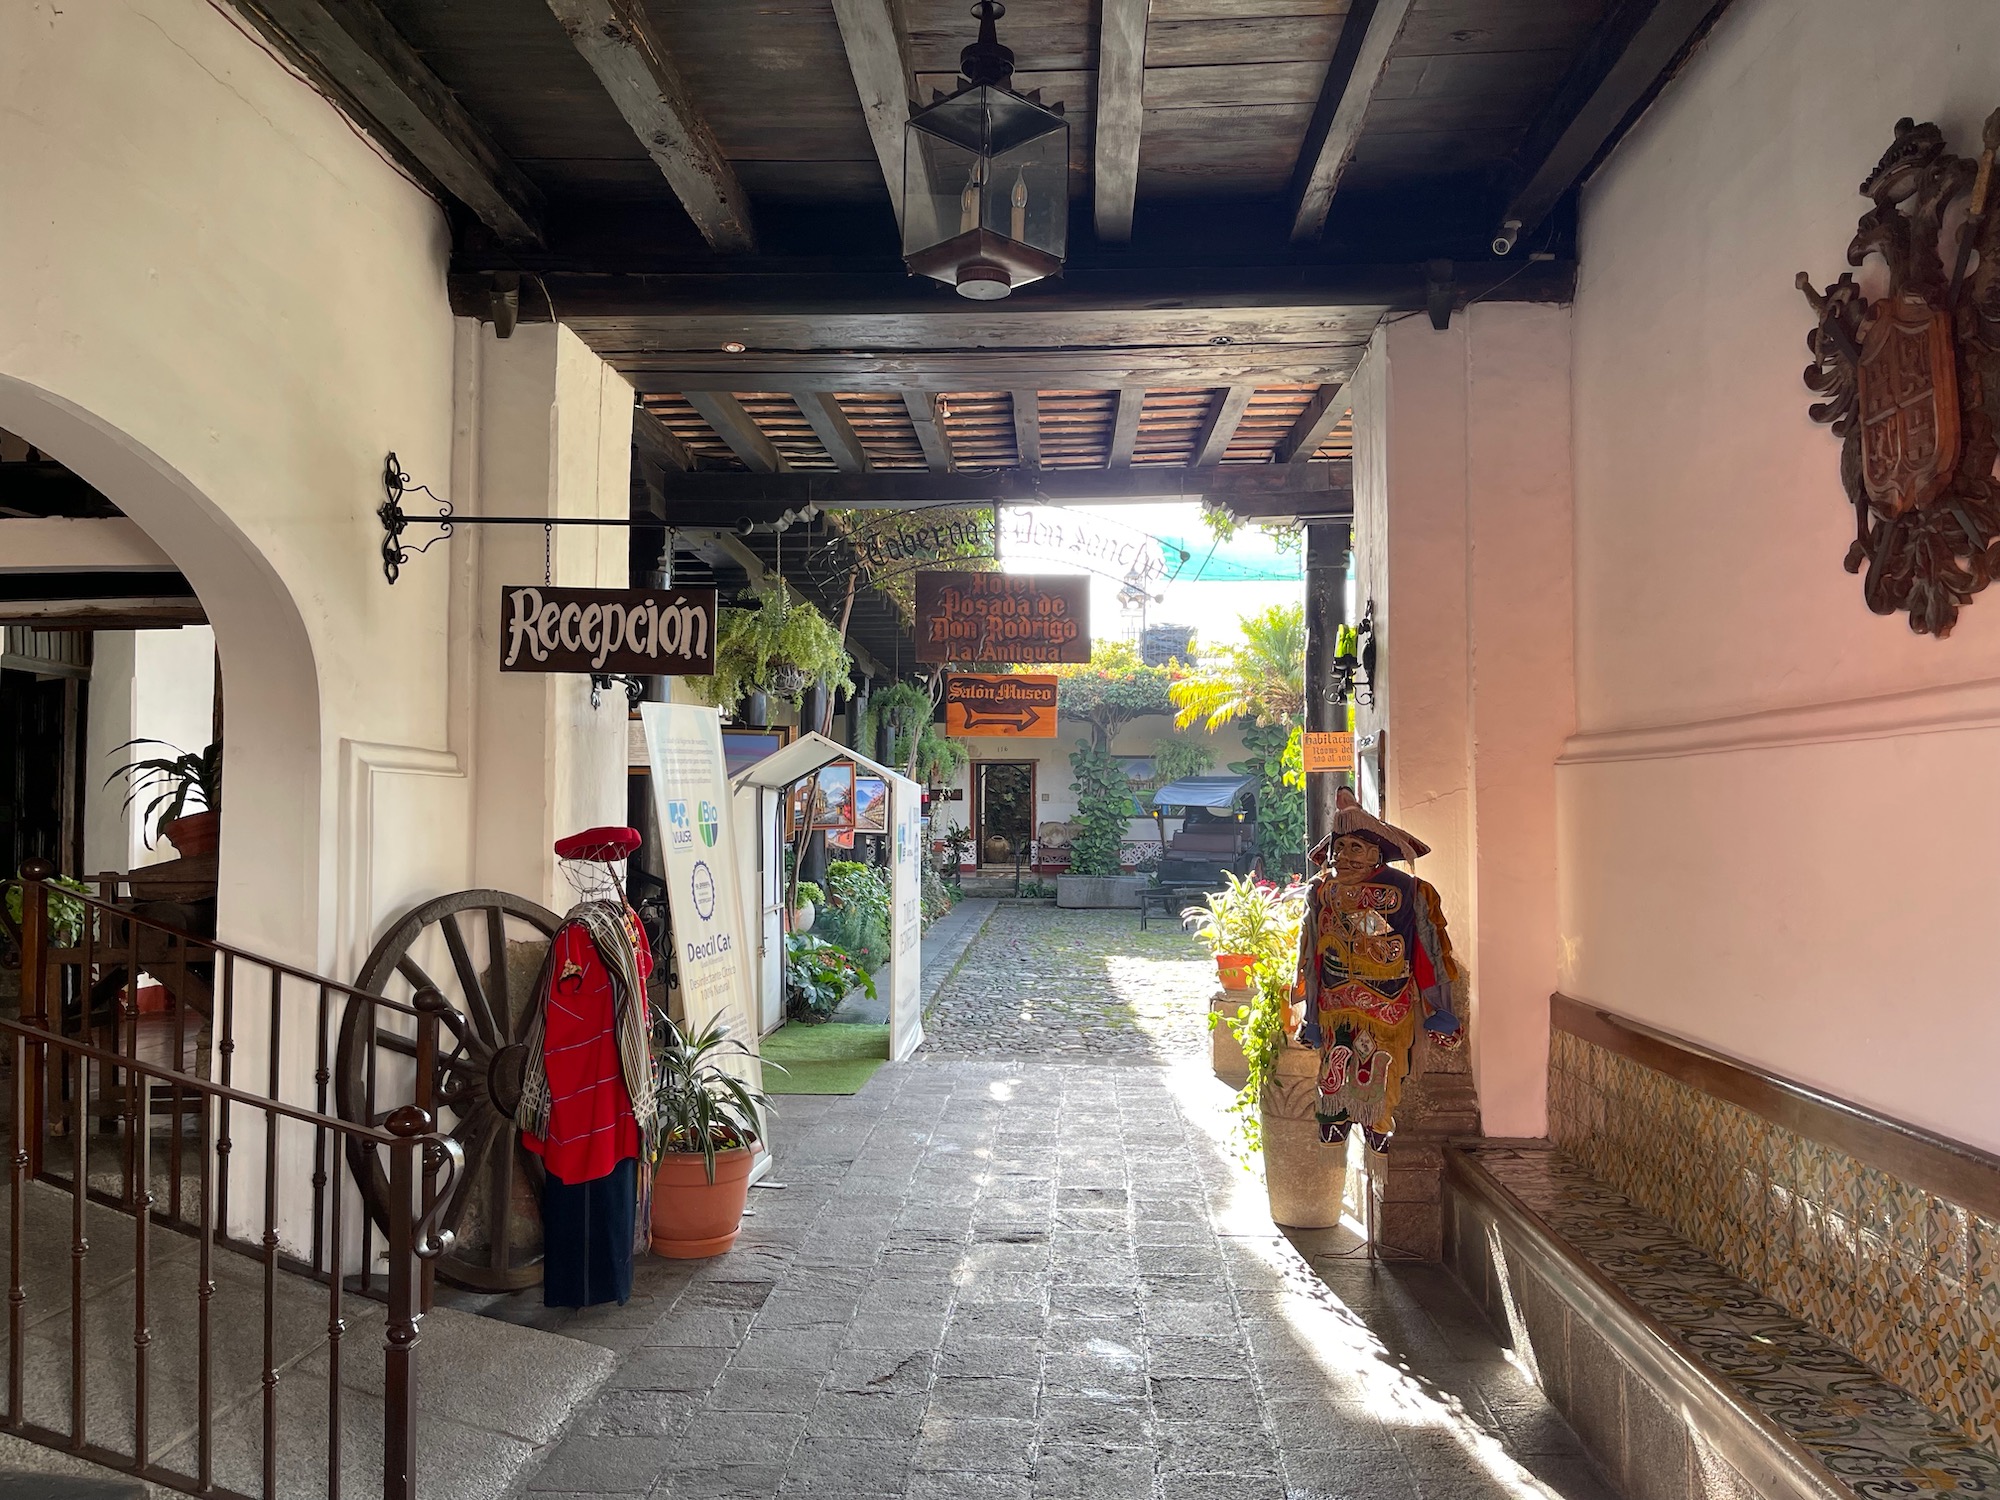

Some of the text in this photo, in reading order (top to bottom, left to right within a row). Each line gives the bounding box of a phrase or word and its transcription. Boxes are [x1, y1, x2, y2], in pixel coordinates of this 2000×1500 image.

[865, 520, 980, 566] Taberna
[971, 572, 1037, 595] Hotel
[942, 586, 1066, 620] Posada de
[505, 588, 707, 669] Recepción
[930, 615, 1078, 644] Don Rodrigo
[948, 641, 1061, 663] La Antigua
[948, 682, 1052, 704] Salón Museo
[702, 801, 718, 822] Bio
[687, 935, 716, 963] Deocil
[717, 933, 732, 952] Cat
